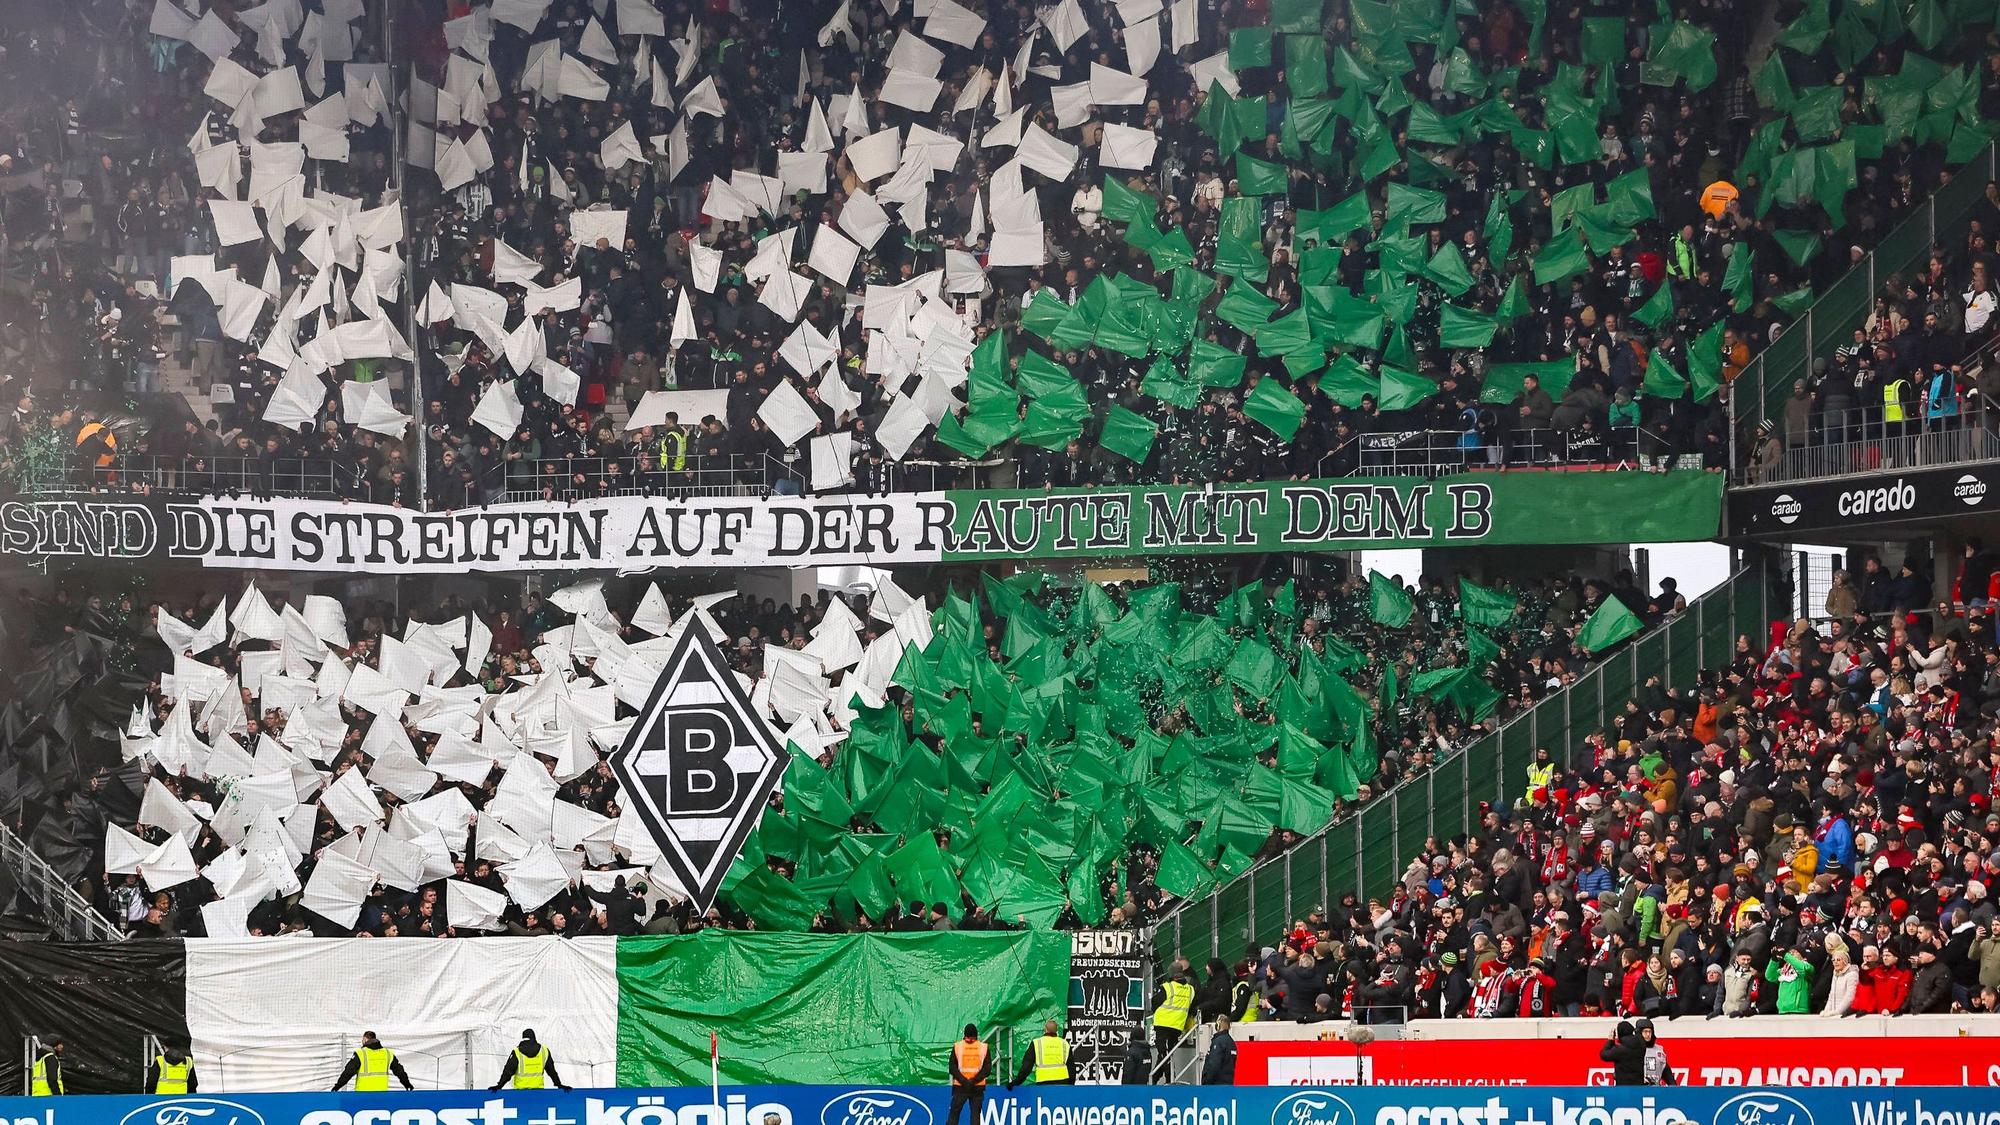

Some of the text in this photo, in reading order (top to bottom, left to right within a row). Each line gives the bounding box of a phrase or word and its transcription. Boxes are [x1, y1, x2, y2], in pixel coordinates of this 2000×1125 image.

[1838, 479, 1916, 517] carado
[1954, 480, 1987, 497] carado
[1771, 500, 1802, 516] carado
[0, 483, 1493, 565] SIND DIE STREIFEN AUF DER RAUTE MIT DEM B
[665, 708, 739, 815] B
[1071, 958, 1141, 969] FREUNDESKREIS
